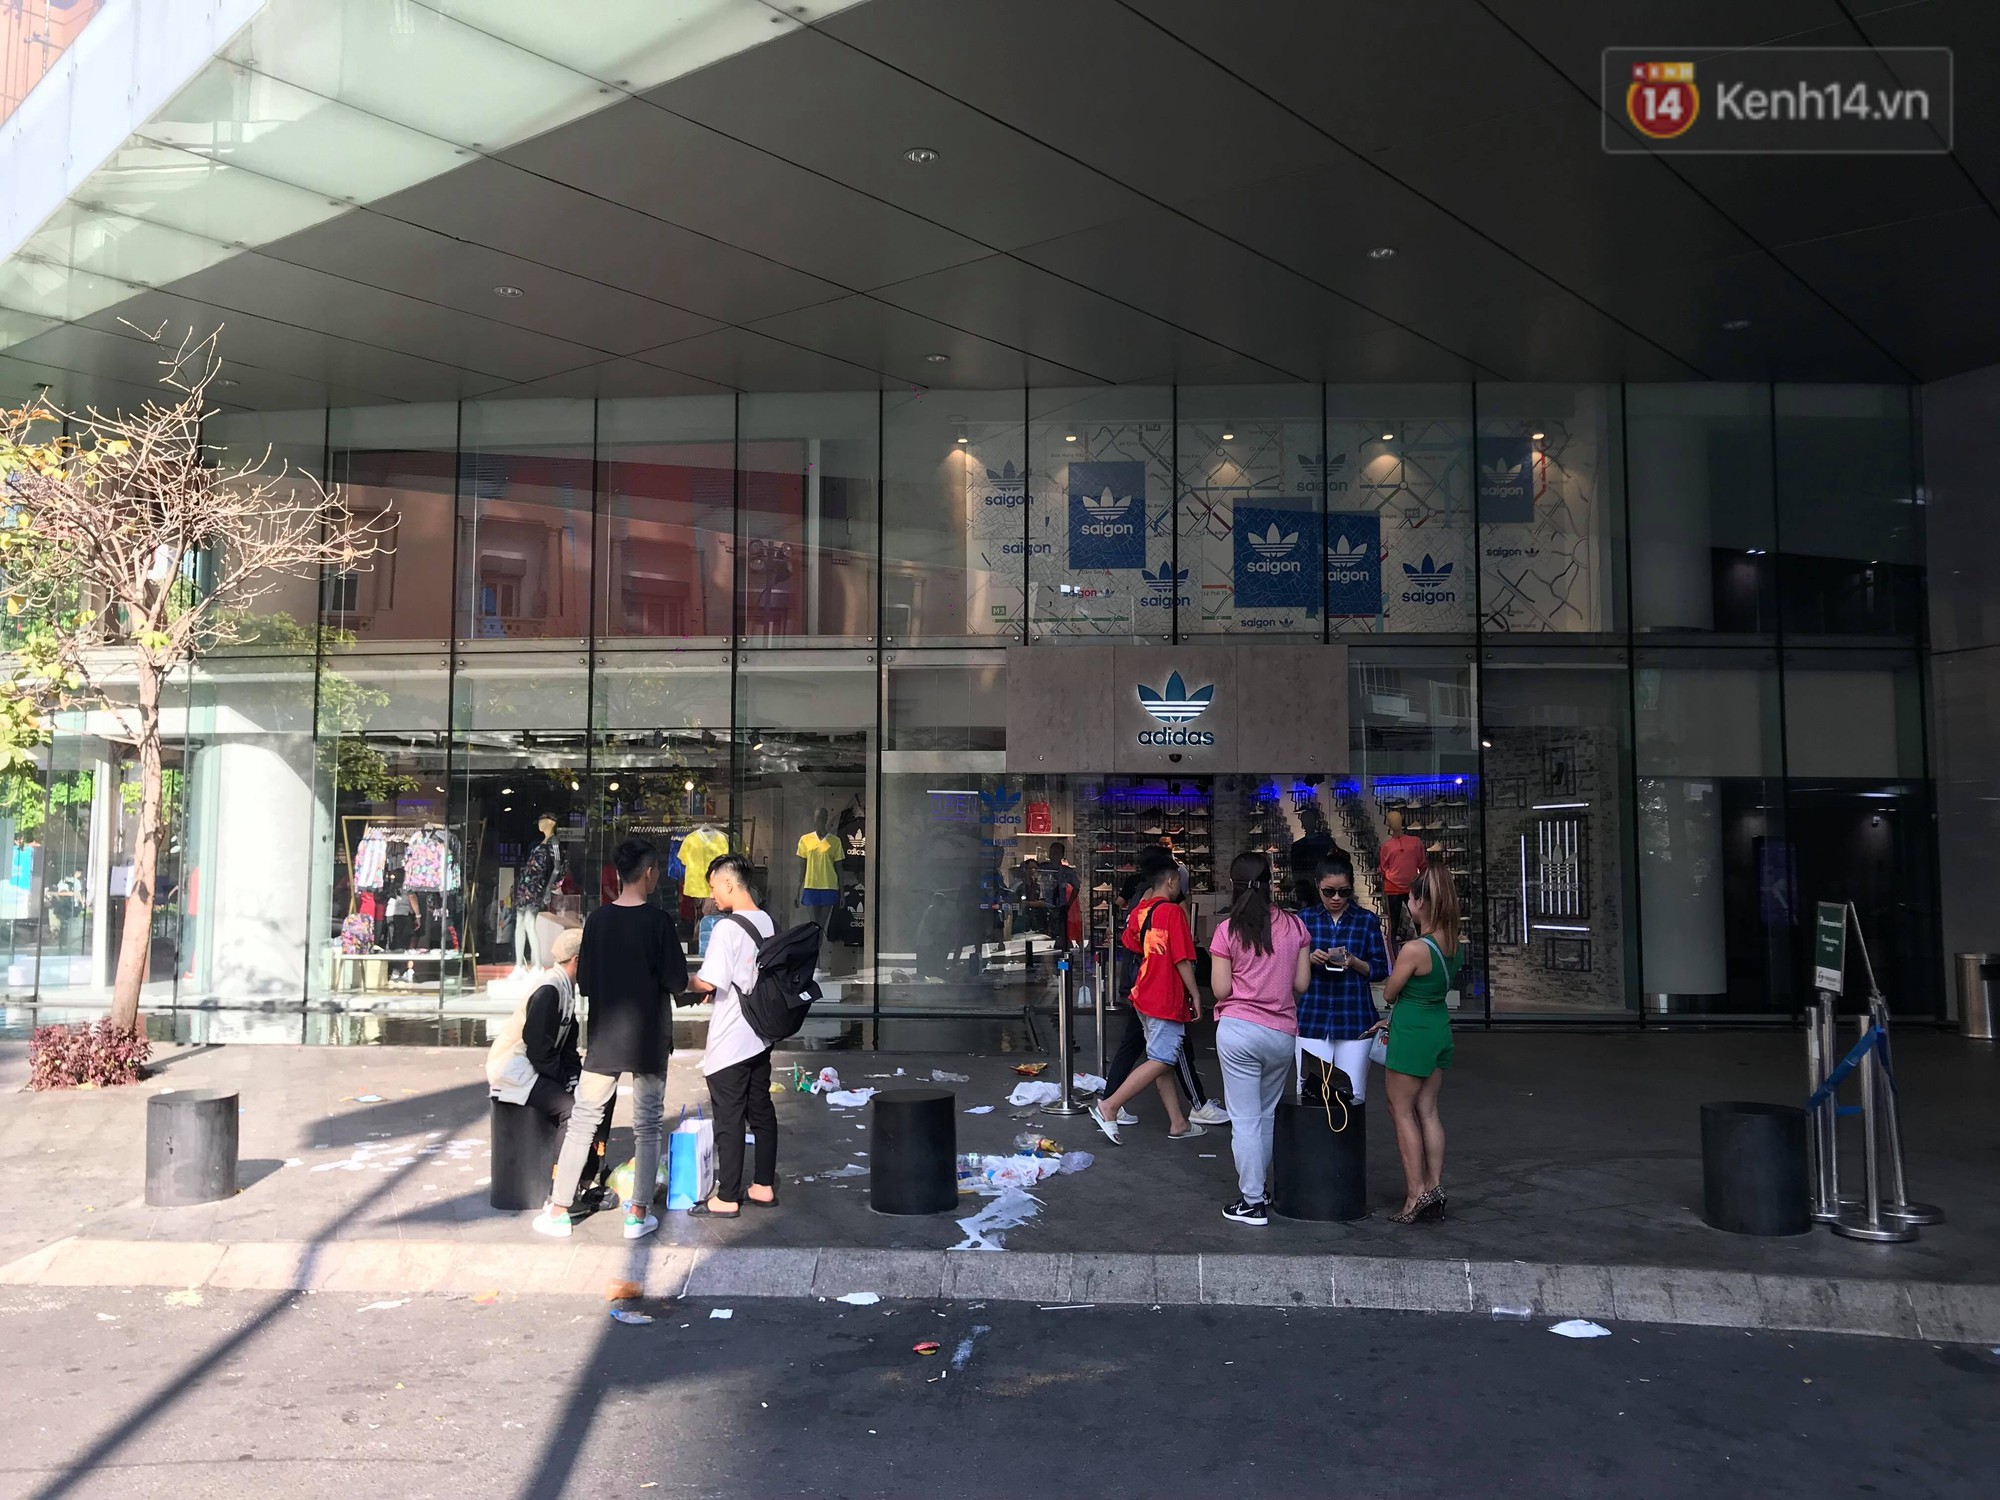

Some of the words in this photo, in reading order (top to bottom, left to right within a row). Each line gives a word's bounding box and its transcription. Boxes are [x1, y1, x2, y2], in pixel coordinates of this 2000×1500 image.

[1480, 485, 1524, 499] saigon
[985, 493, 1034, 509] saigon
[1081, 521, 1134, 538] saigon
[1486, 548, 1522, 559] saigon
[1246, 560, 1301, 575] saigon
[1320, 569, 1369, 584] aigon
[1140, 595, 1191, 610] saigon
[1402, 590, 1456, 605] saigon
[992, 606, 1006, 615] M3
[1240, 618, 1276, 629] saigon
[1137, 725, 1215, 747] adidas
[931, 795, 978, 815] OPEN
[979, 814, 1021, 824] adidas
[1540, 880, 1579, 892] adidas
